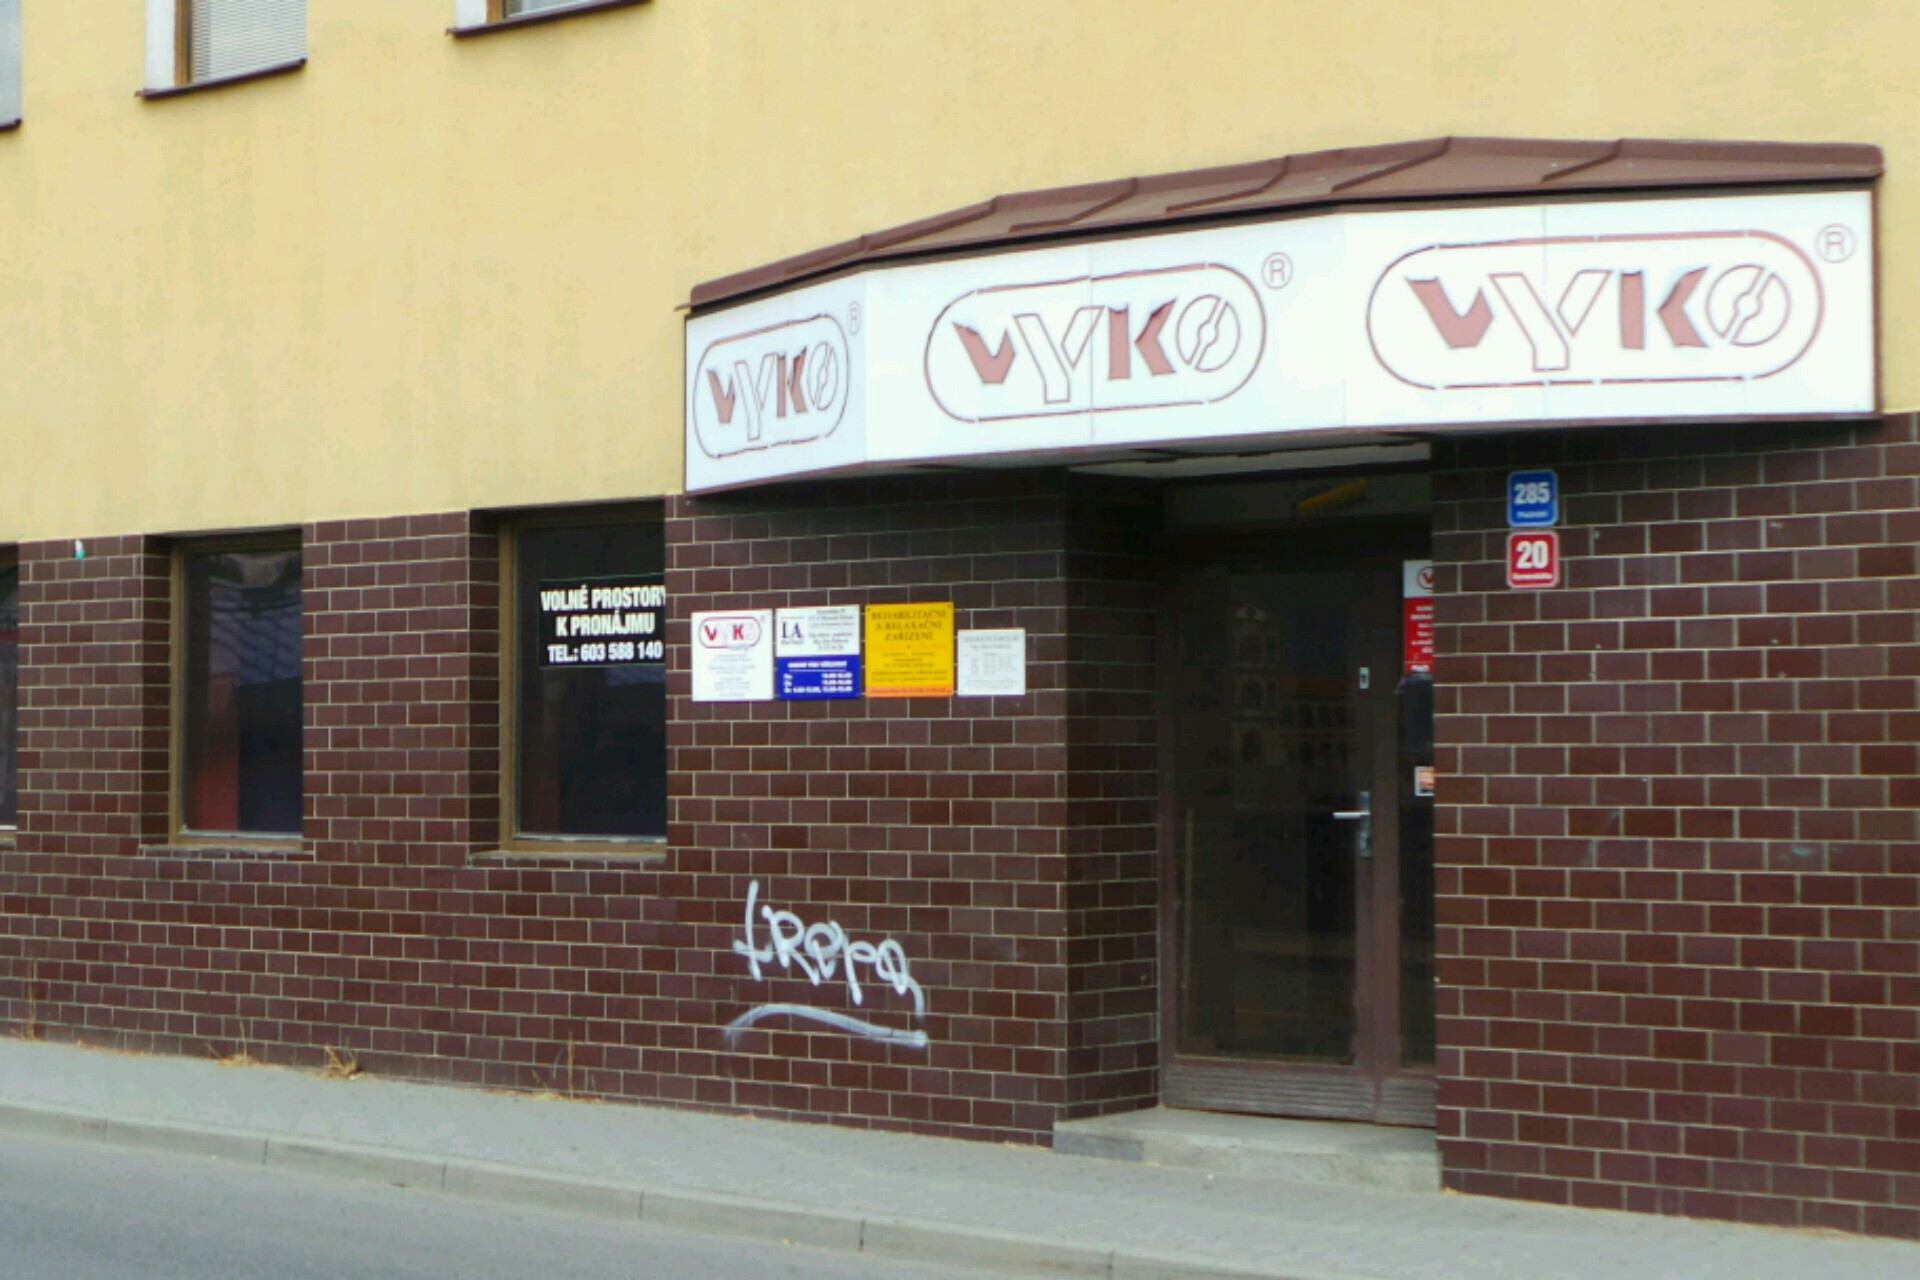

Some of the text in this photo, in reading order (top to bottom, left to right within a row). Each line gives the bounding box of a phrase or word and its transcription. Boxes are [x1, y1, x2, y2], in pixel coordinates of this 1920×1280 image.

[1514, 481, 1550, 505] 285
[1516, 539, 1549, 570] 20
[540, 583, 588, 611] VOLNÉ
[556, 608, 656, 637] K PRONÁJMU
[580, 642, 606, 662] 603
[638, 640, 664, 660] 140
